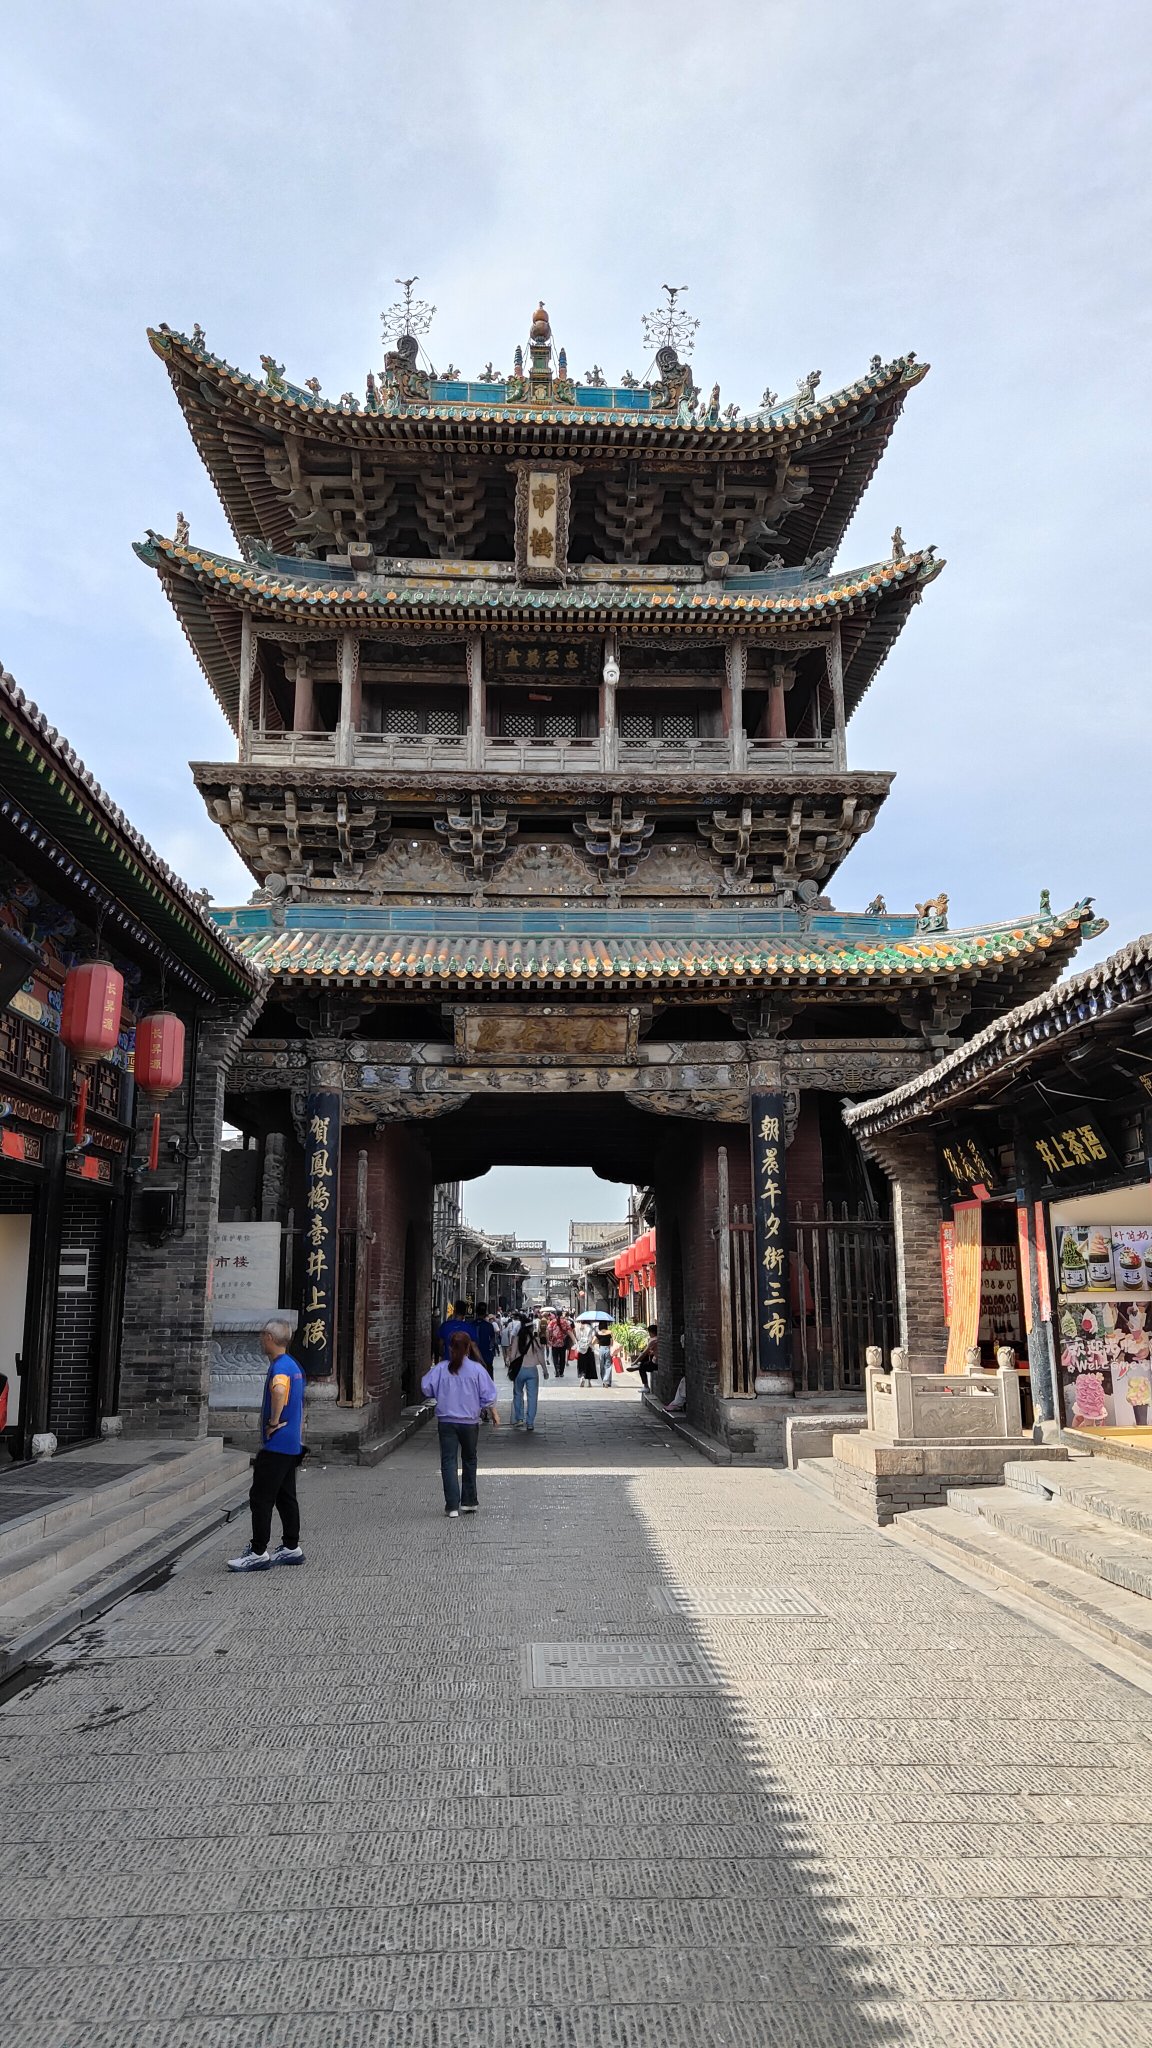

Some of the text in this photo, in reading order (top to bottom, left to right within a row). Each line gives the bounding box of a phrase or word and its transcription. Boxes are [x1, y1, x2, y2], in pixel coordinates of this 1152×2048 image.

[1035, 1124, 1108, 1174] 井上茶语
[216, 1255, 250, 1268] 市楼
[1075, 1359, 1138, 1372] Welcome
